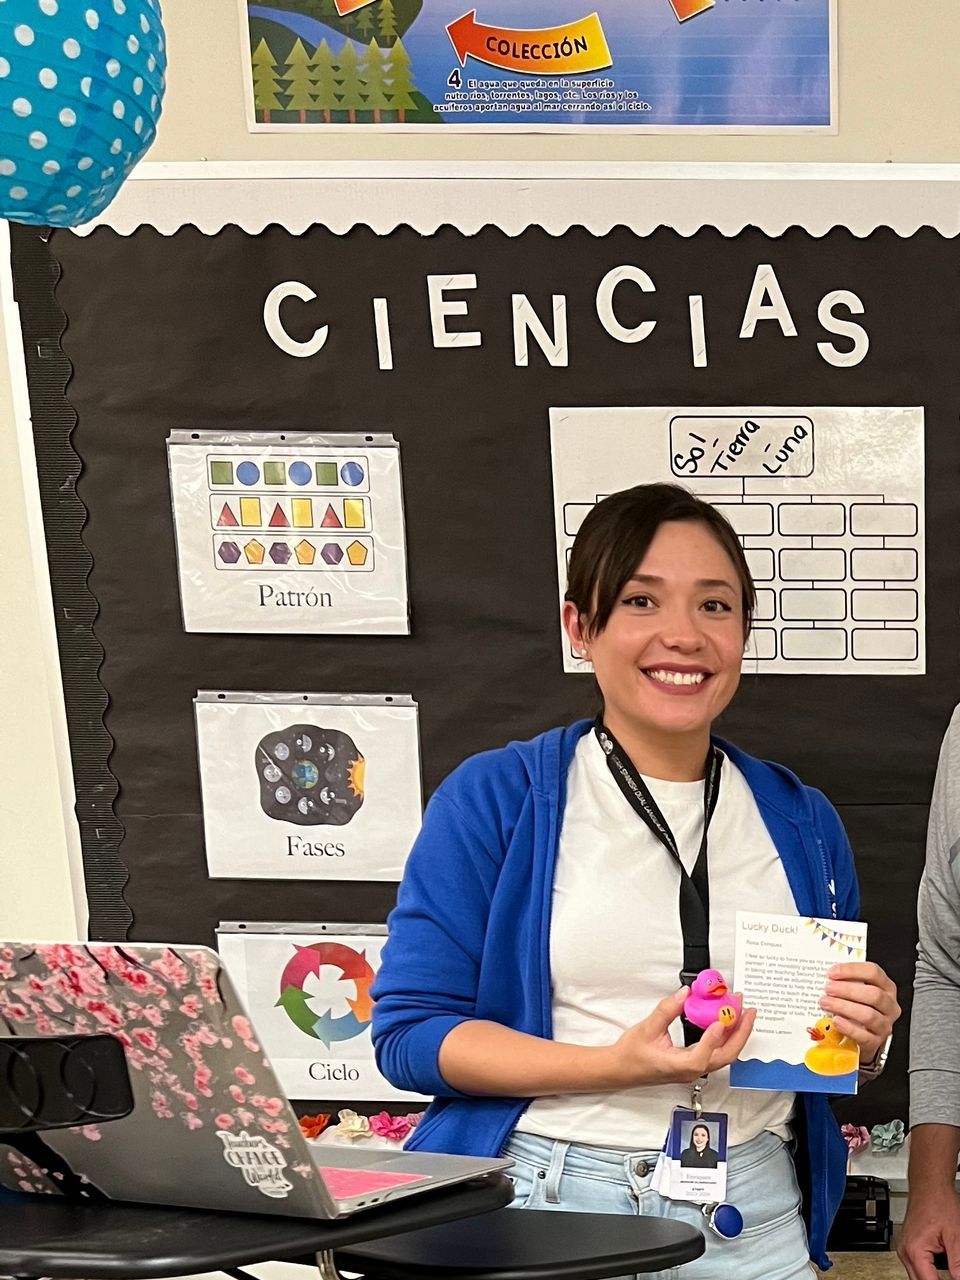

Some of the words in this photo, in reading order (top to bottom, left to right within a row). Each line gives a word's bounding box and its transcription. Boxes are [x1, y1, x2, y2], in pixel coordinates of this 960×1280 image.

[486, 36, 588, 59] COLECCIÓN
[448, 69, 462, 88] 4
[479, 81, 499, 90] agua
[502, 81, 517, 90] que
[520, 79, 546, 90] queda
[560, 79, 569, 88] la
[571, 79, 613, 90] superficie
[445, 90, 467, 99] nutre
[475, 103, 508, 112] aportan
[510, 103, 531, 112] agua
[534, 102, 541, 111] al
[543, 103, 561, 111] mar
[563, 102, 601, 111] cerrando
[263, 263, 871, 372] CIENCIAS
[711, 419, 761, 474] Tierra
[257, 582, 334, 610] Patrón
[285, 836, 345, 858] Fases
[742, 921, 768, 933] Lucky
[772, 924, 798, 934] Duck!
[308, 1062, 360, 1082] Ciclo
